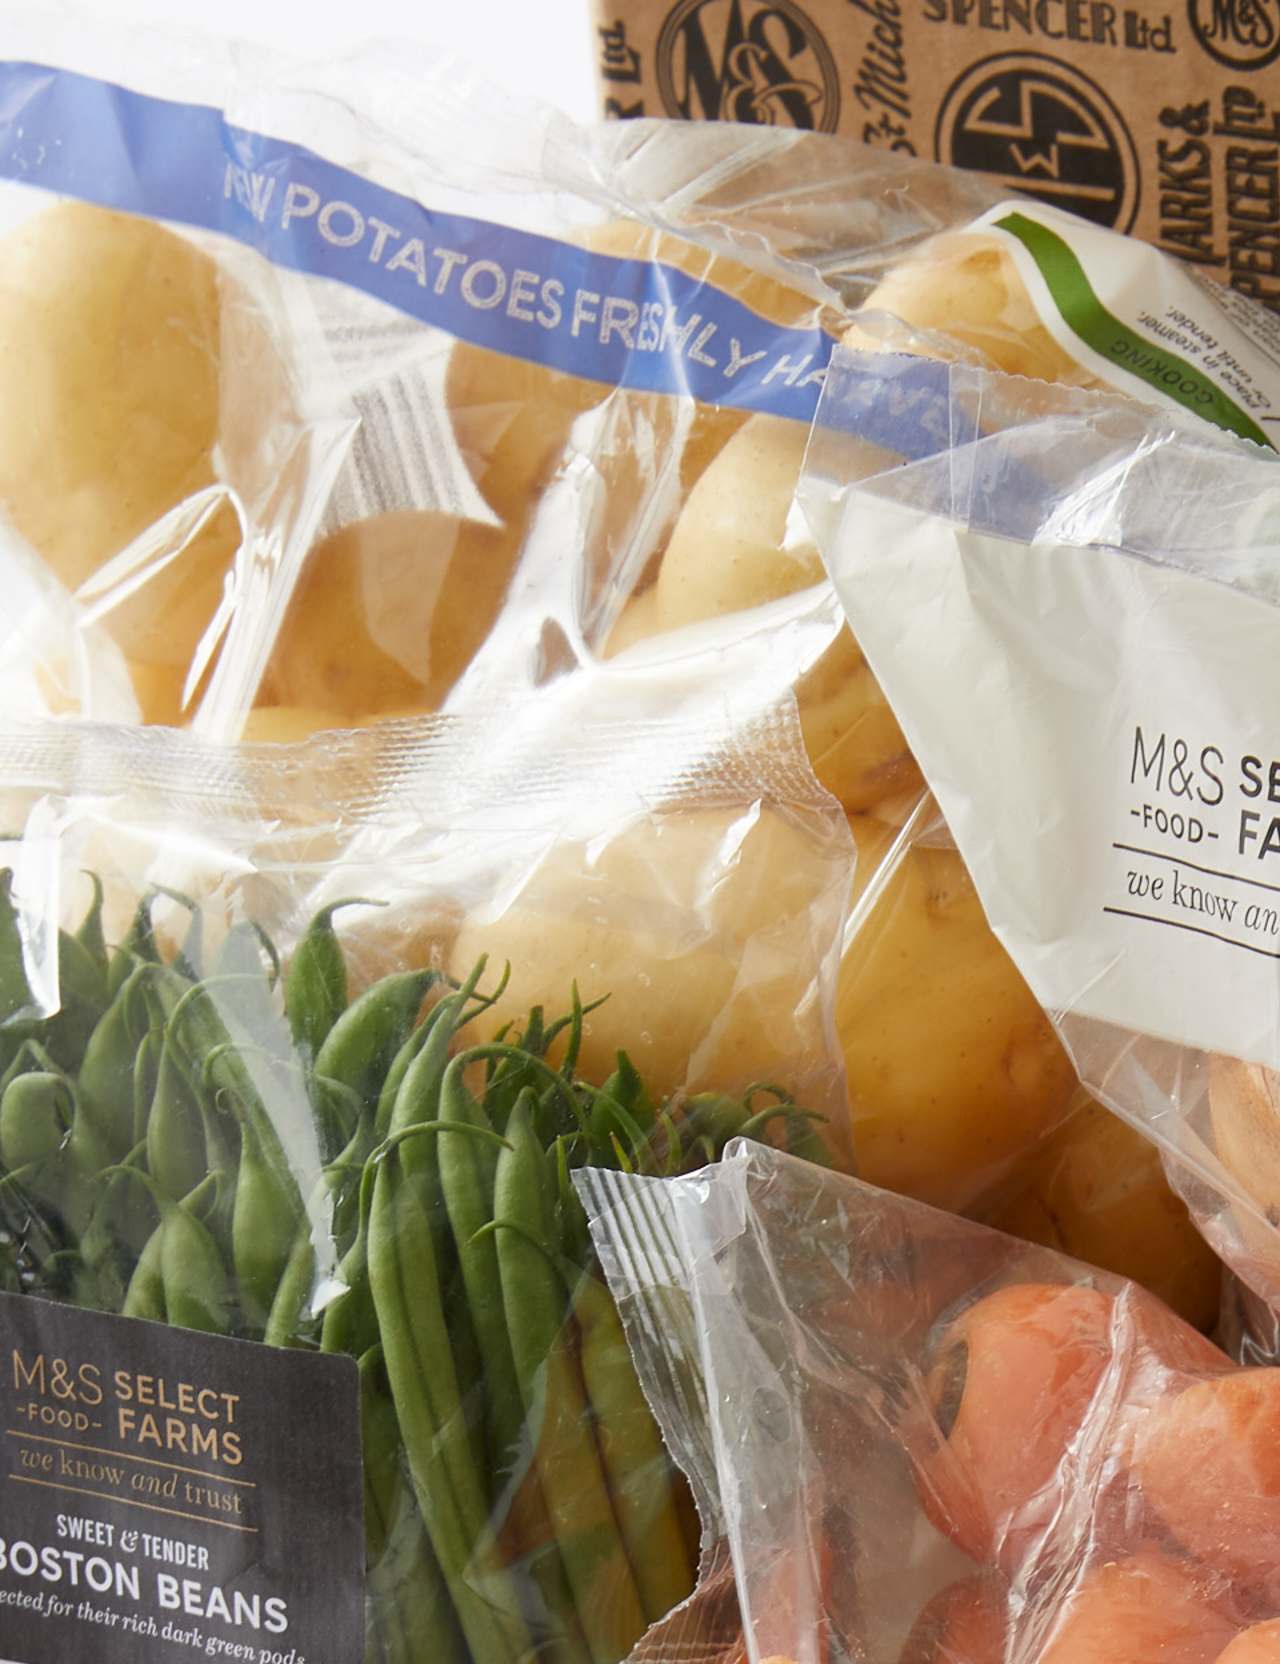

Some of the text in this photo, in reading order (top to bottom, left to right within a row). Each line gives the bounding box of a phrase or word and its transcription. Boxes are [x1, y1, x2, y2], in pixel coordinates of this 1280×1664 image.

[281, 181, 563, 331] POTATOES
[1131, 726, 1224, 807] M&S
[1127, 869, 1164, 901] we
[1173, 869, 1237, 924] know
[12, 1349, 240, 1424] M&S SELECT
[118, 1407, 243, 1466] FARMS
[20, 1448, 243, 1514] we know and trust
[57, 1513, 114, 1547] SWEET
[142, 1537, 209, 1571] TENDER
[43, 1596, 73, 1617] for
[77, 1603, 119, 1626] their
[122, 1616, 158, 1637] rich
[161, 1621, 202, 1648] dark
[205, 1636, 255, 1661] green
[157, 1573, 288, 1633] BEANS
